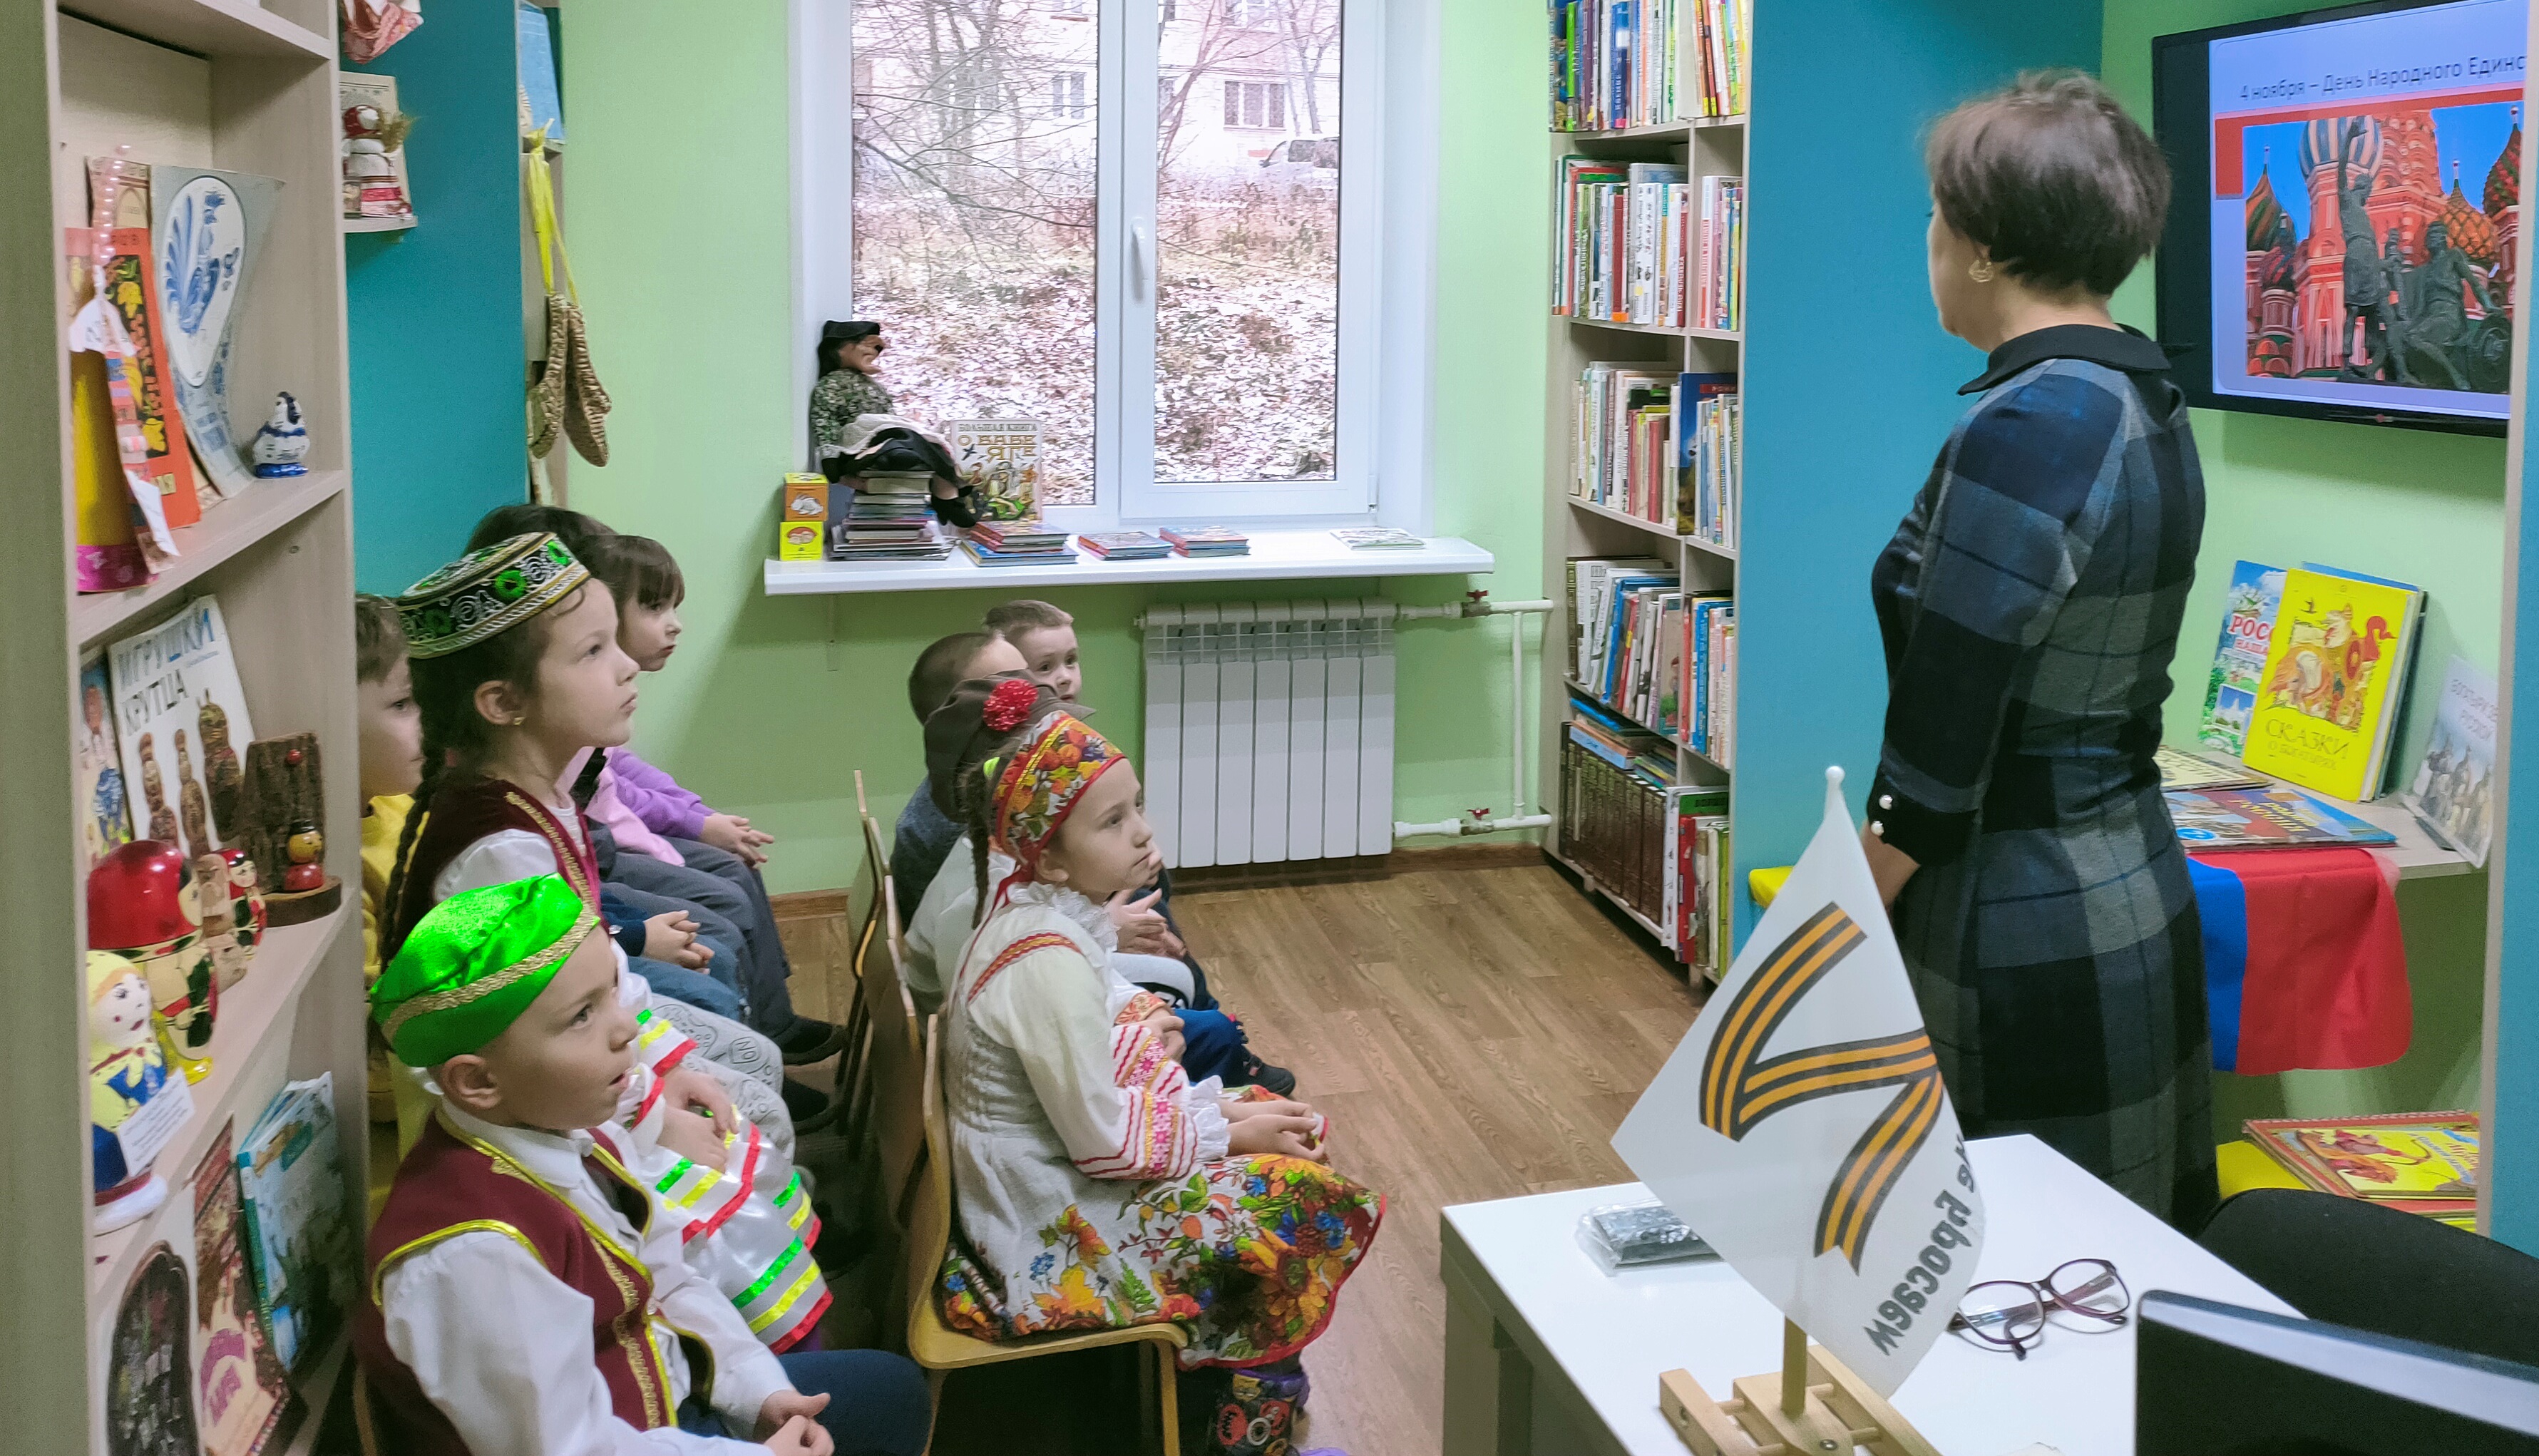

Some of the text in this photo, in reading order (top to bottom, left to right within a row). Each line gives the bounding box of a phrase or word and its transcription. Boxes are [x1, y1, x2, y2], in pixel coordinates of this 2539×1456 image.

[2240, 84, 2248, 101] 4
[2250, 78, 2305, 100] ноября
[2322, 73, 2364, 96] День
[2367, 61, 2463, 89] Народного
[2468, 56, 2526, 78] Единс
[958, 434, 972, 446] О
[984, 446, 1037, 463] ЯГЕ
[2229, 614, 2275, 641] РОС
[2265, 718, 2350, 759] СКАЗКИ
